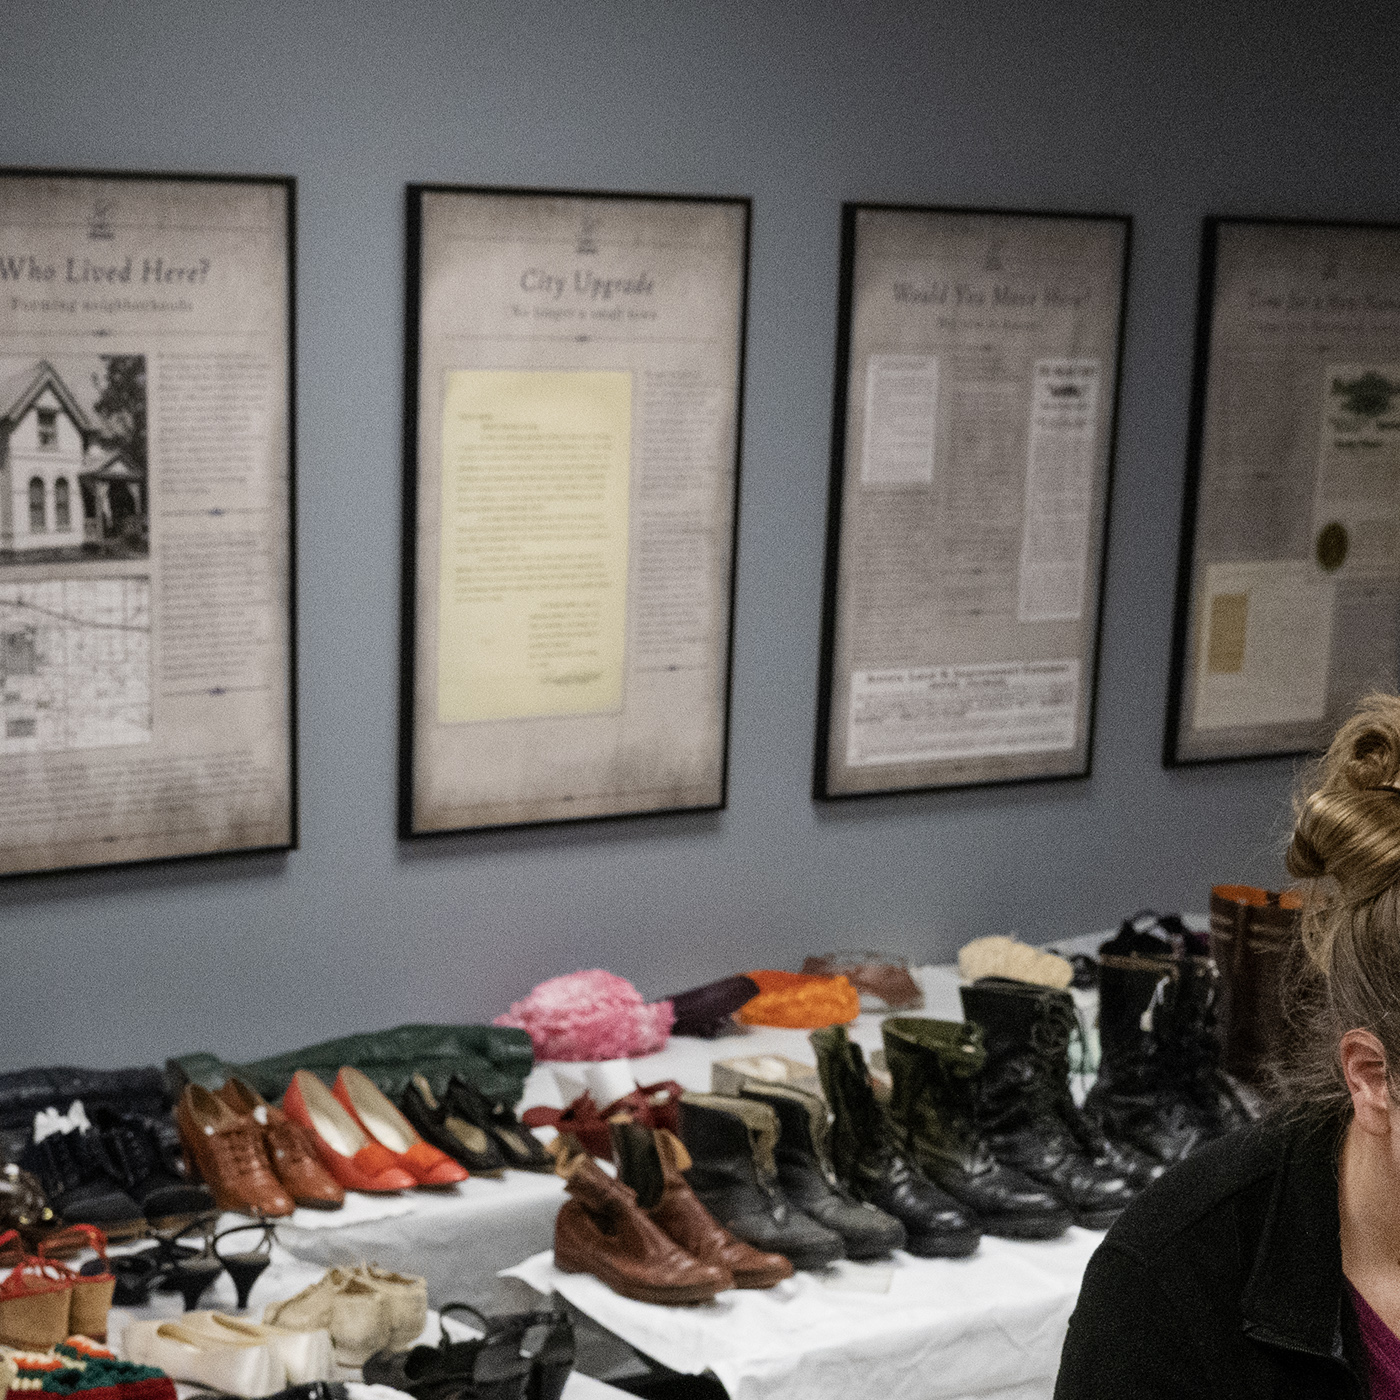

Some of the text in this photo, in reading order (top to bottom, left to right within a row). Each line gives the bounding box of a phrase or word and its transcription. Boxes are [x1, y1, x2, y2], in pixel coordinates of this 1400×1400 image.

[65, 255, 132, 284] Lived
[142, 257, 211, 285] Here?
[520, 268, 655, 300] City Upgrade
